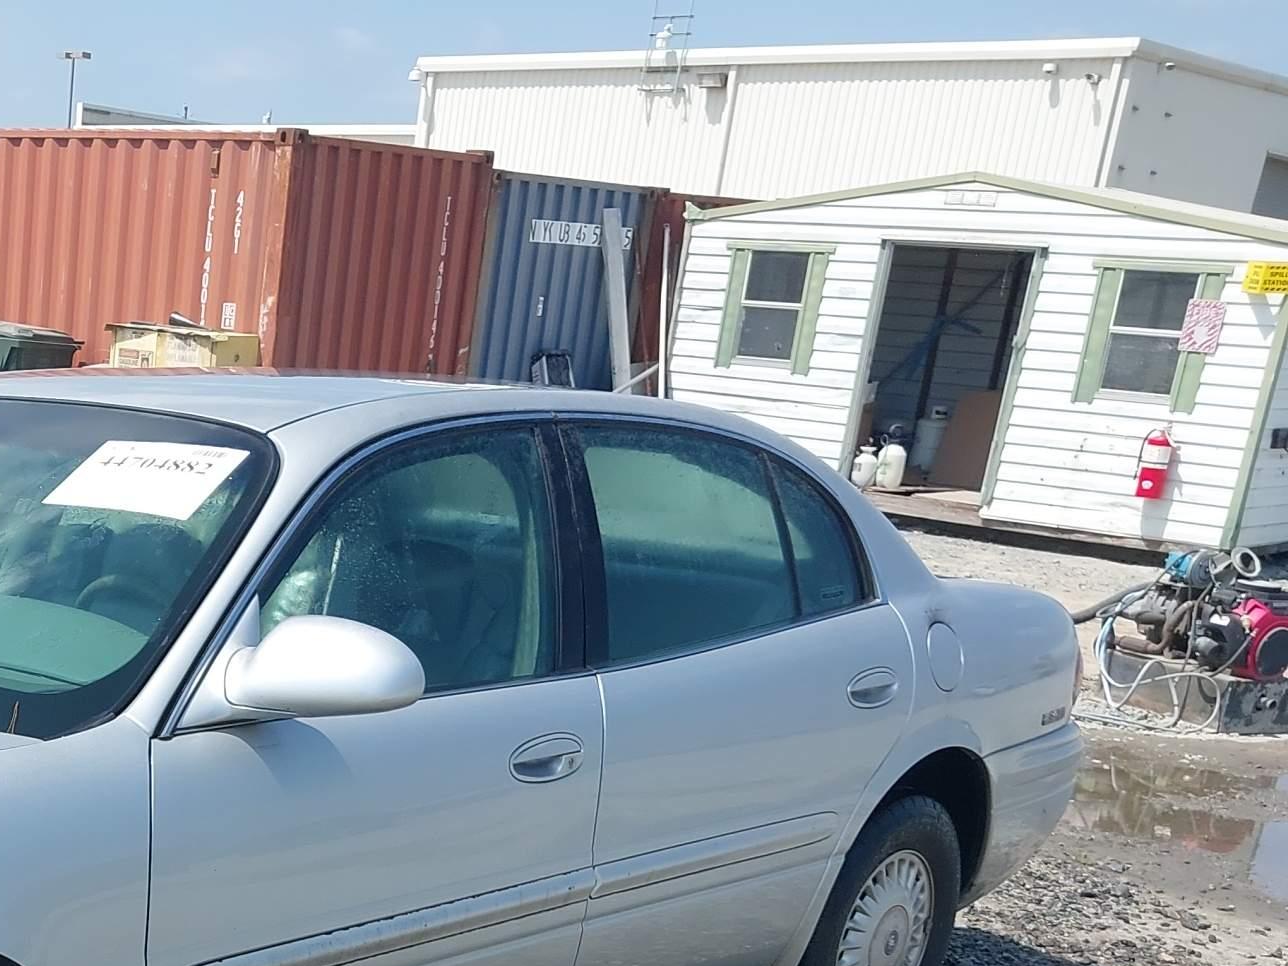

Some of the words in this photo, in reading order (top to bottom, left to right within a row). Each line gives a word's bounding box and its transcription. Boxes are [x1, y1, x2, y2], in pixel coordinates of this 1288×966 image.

[204, 188, 217, 253] TCLU
[233, 190, 245, 254] 42G1
[99, 455, 213, 475] 44704882
